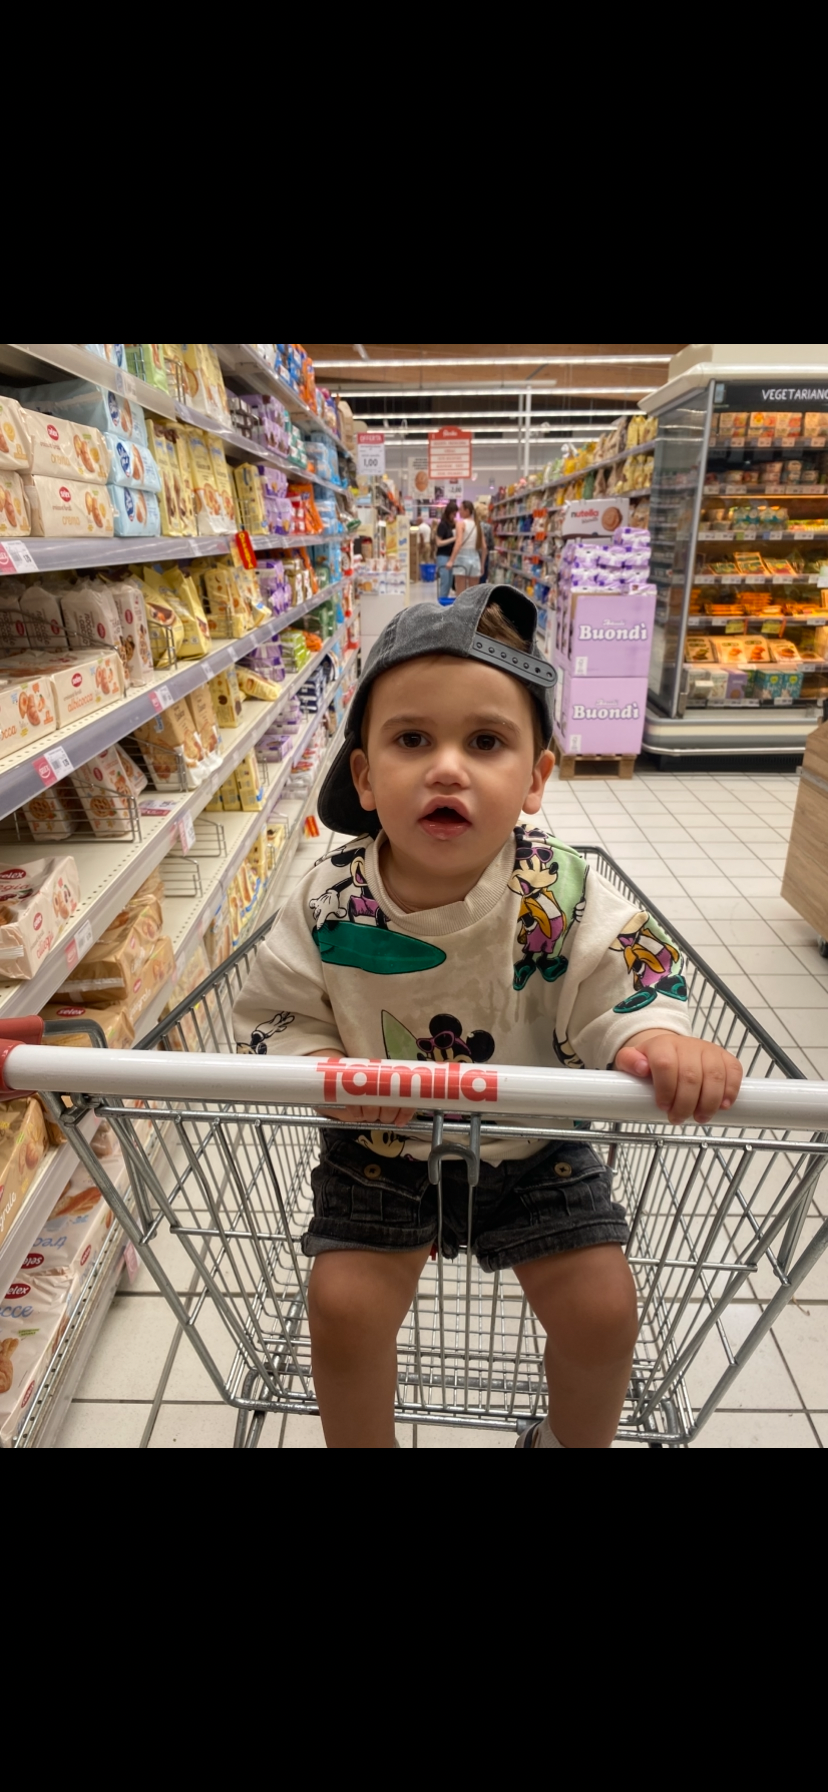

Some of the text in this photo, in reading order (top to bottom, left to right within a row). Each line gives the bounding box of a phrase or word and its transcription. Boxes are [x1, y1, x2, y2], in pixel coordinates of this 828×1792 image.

[571, 508, 599, 518] nutella
[579, 623, 647, 640] Buondì
[573, 703, 639, 719] Buondì
[58, 1008, 84, 1016] selex
[316, 1057, 498, 1102] famila
